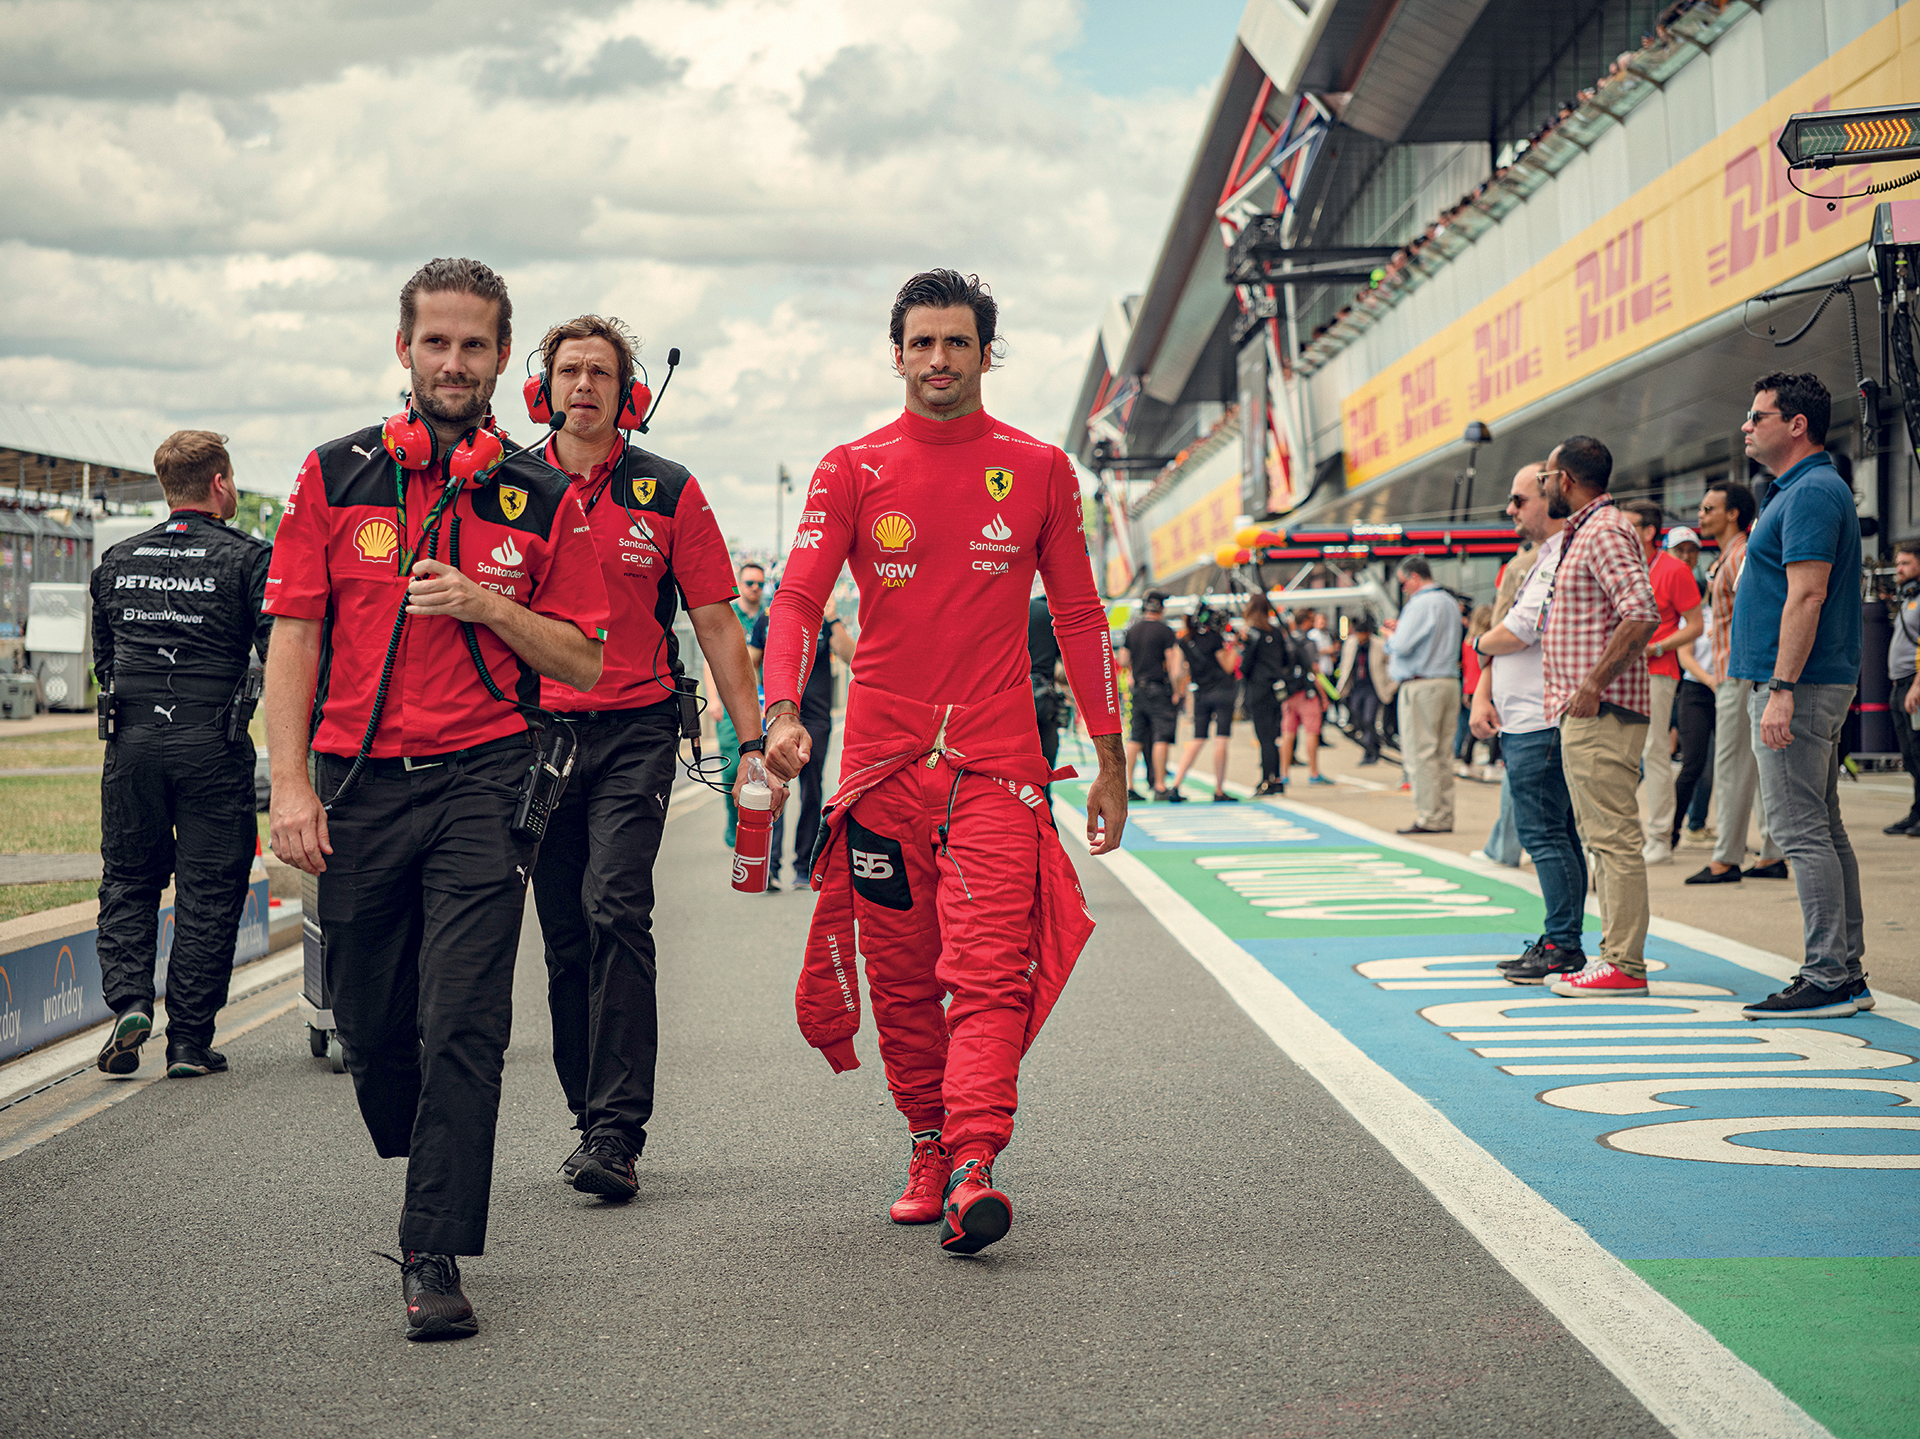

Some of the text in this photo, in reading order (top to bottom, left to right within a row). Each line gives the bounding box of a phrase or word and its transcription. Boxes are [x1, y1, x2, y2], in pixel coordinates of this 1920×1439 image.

[1575, 219, 1653, 352] DHL
[1474, 299, 1530, 406] DHL
[157, 547, 207, 558] AMG
[969, 540, 1021, 553] Santander
[477, 562, 525, 579] Santander
[873, 562, 918, 579] VGW
[114, 574, 217, 593] PETRONAS
[881, 578, 907, 588] PLAY
[135, 608, 204, 624] TeamViewer
[797, 626, 810, 695] RICHARD MILLE
[1100, 631, 1116, 714] RICHARD MILLE
[851, 848, 895, 880] 55
[827, 934, 856, 1012] RICHARD MILLE
